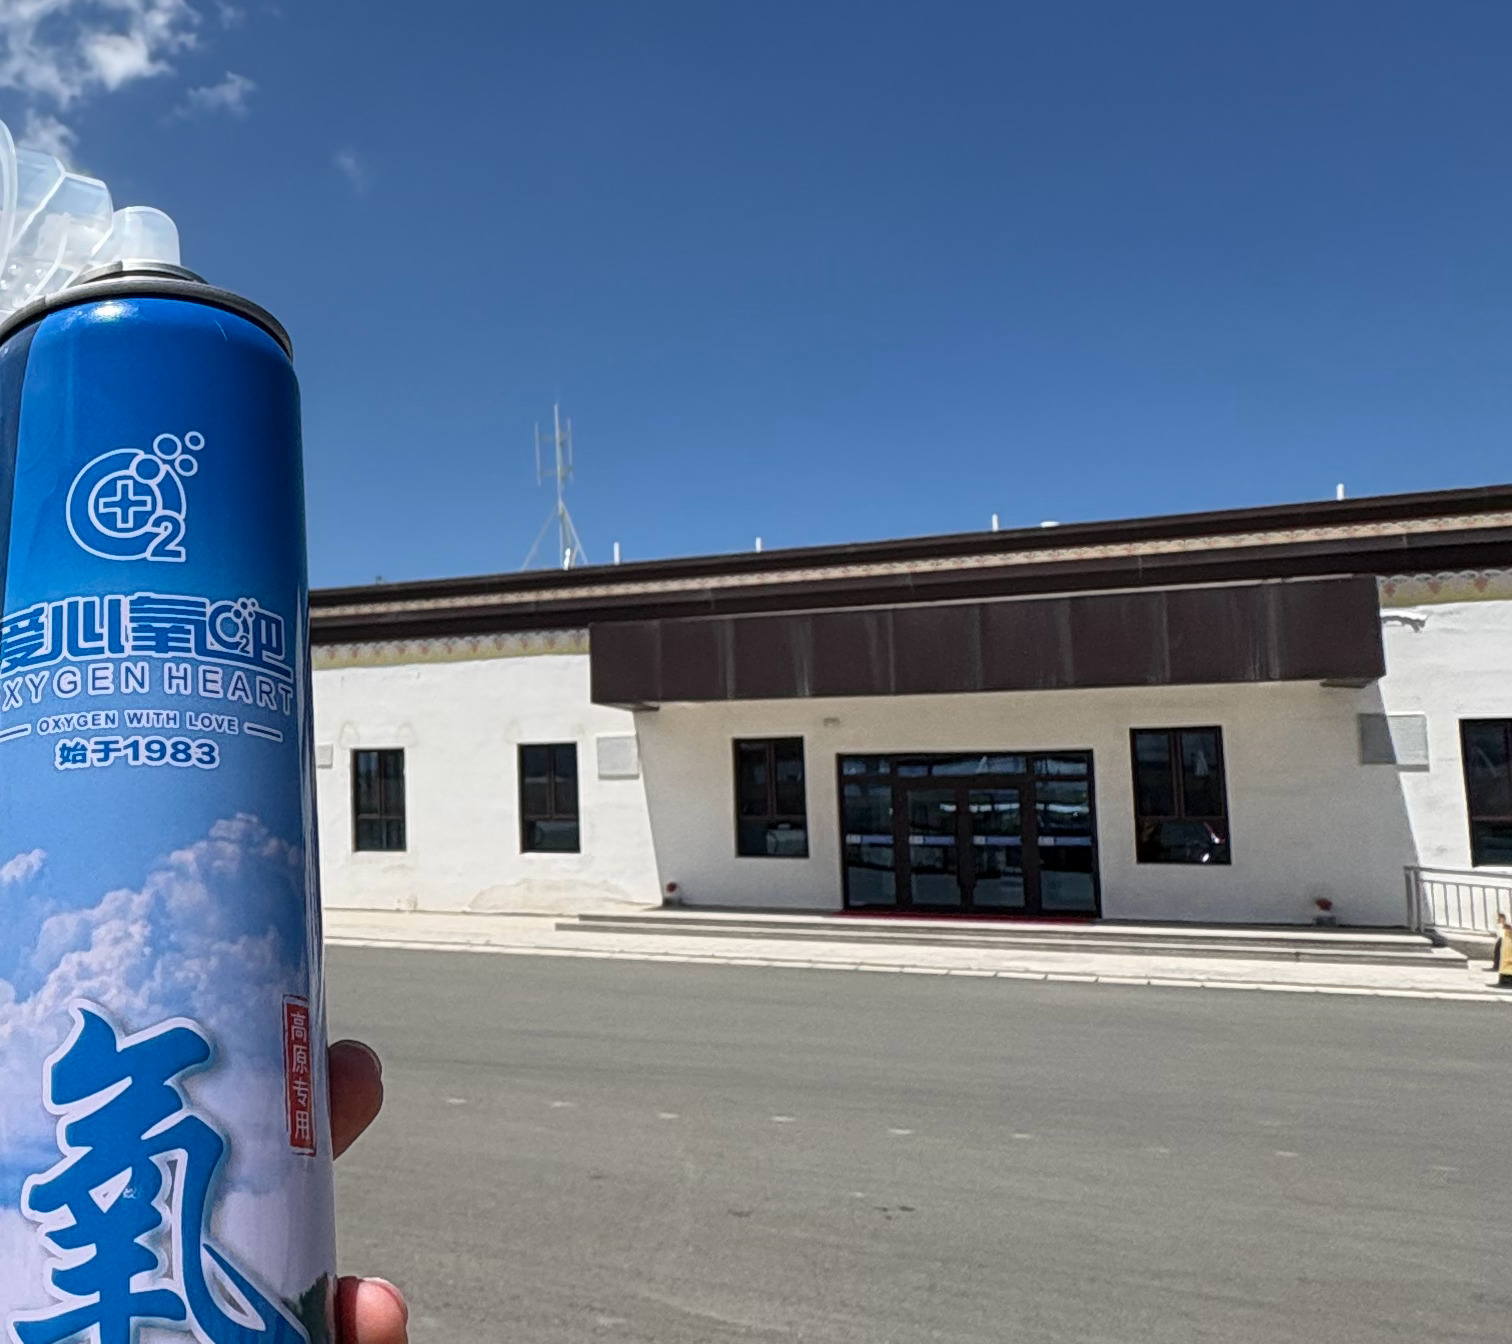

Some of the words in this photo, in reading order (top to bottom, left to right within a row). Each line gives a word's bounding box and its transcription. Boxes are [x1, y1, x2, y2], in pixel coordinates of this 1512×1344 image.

[163, 662, 294, 715] HEART
[37, 711, 119, 735] OXYGEN
[126, 709, 180, 729] WITH
[186, 711, 239, 734] LOVE
[55, 736, 219, 769] 始于1983
[290, 1011, 311, 1140] 高原专用
